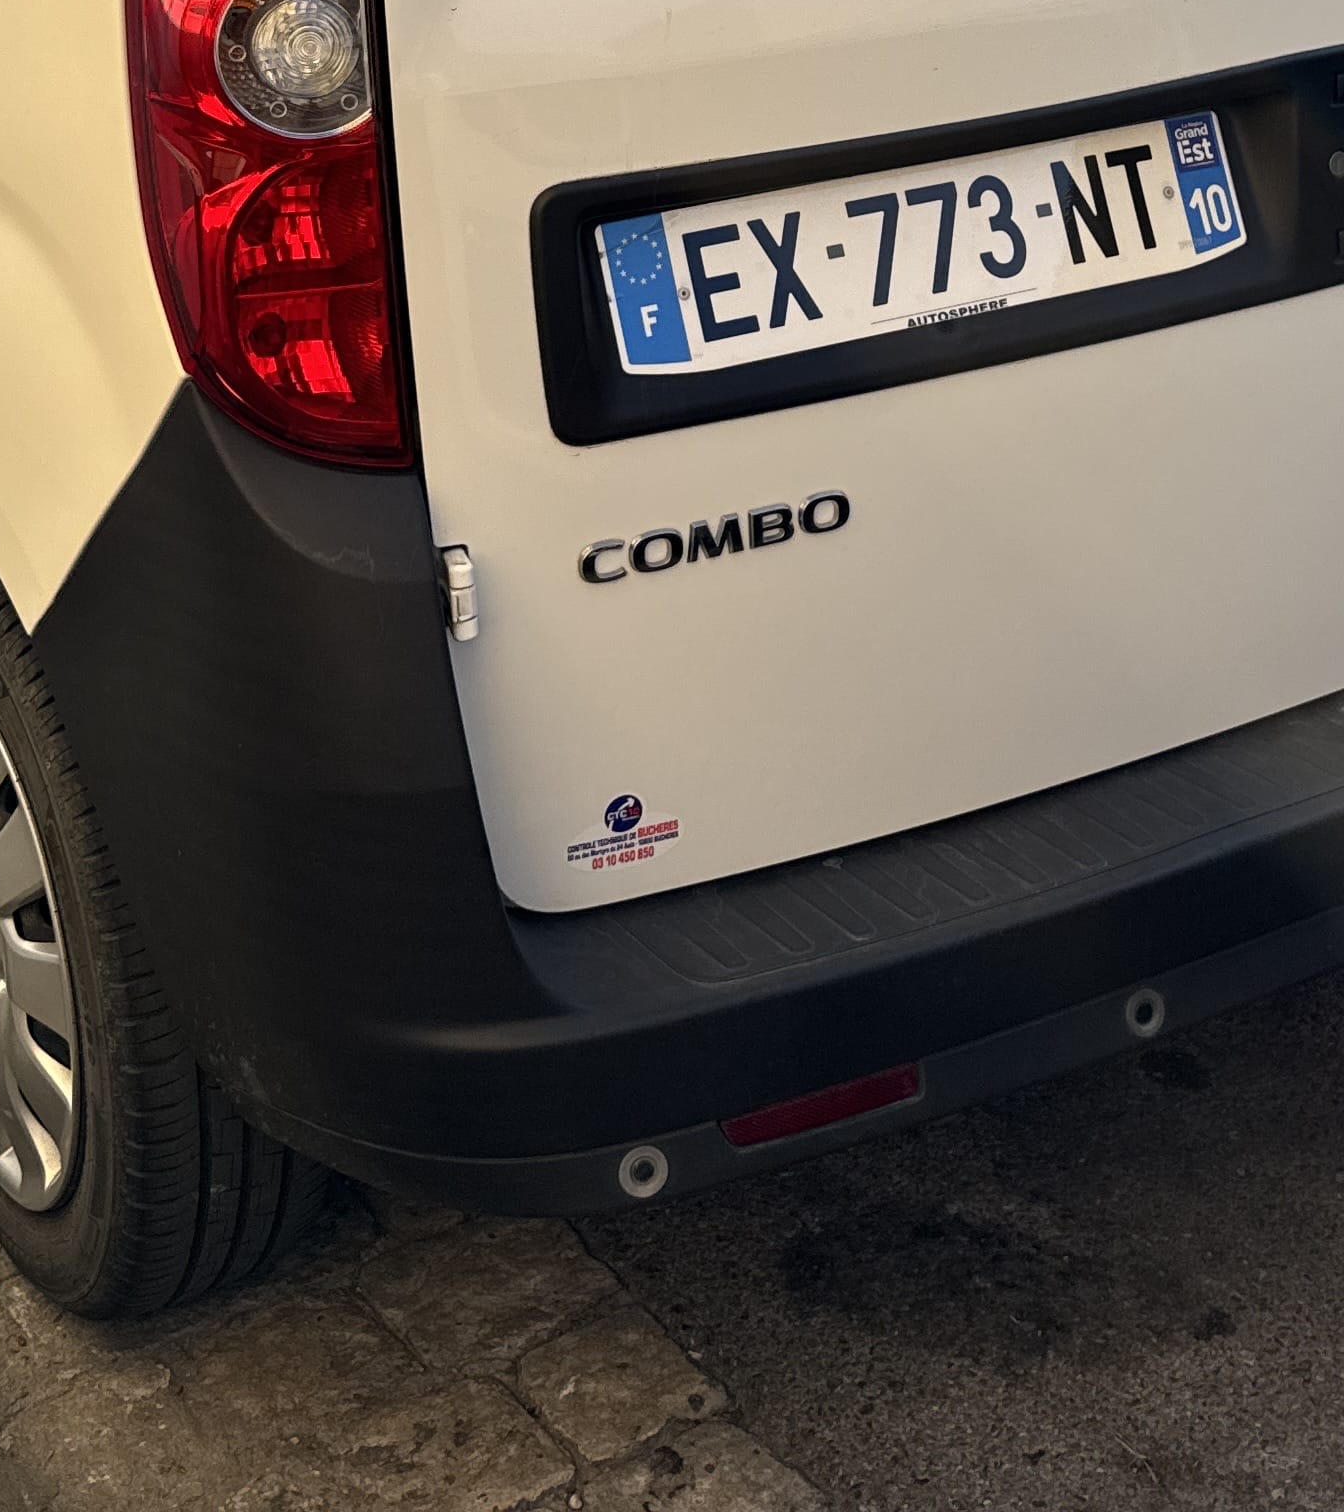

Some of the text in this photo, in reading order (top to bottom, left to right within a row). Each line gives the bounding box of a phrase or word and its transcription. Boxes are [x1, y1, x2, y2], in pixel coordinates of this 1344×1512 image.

[1174, 123, 1208, 141] Grand
[1177, 138, 1214, 165] Est
[1189, 184, 1233, 235] 10
[640, 304, 658, 338] F
[907, 298, 1008, 328] AUTOSPHERE
[578, 489, 850, 583] COMBO
[605, 854, 617, 867] 10
[618, 849, 636, 864] 450
